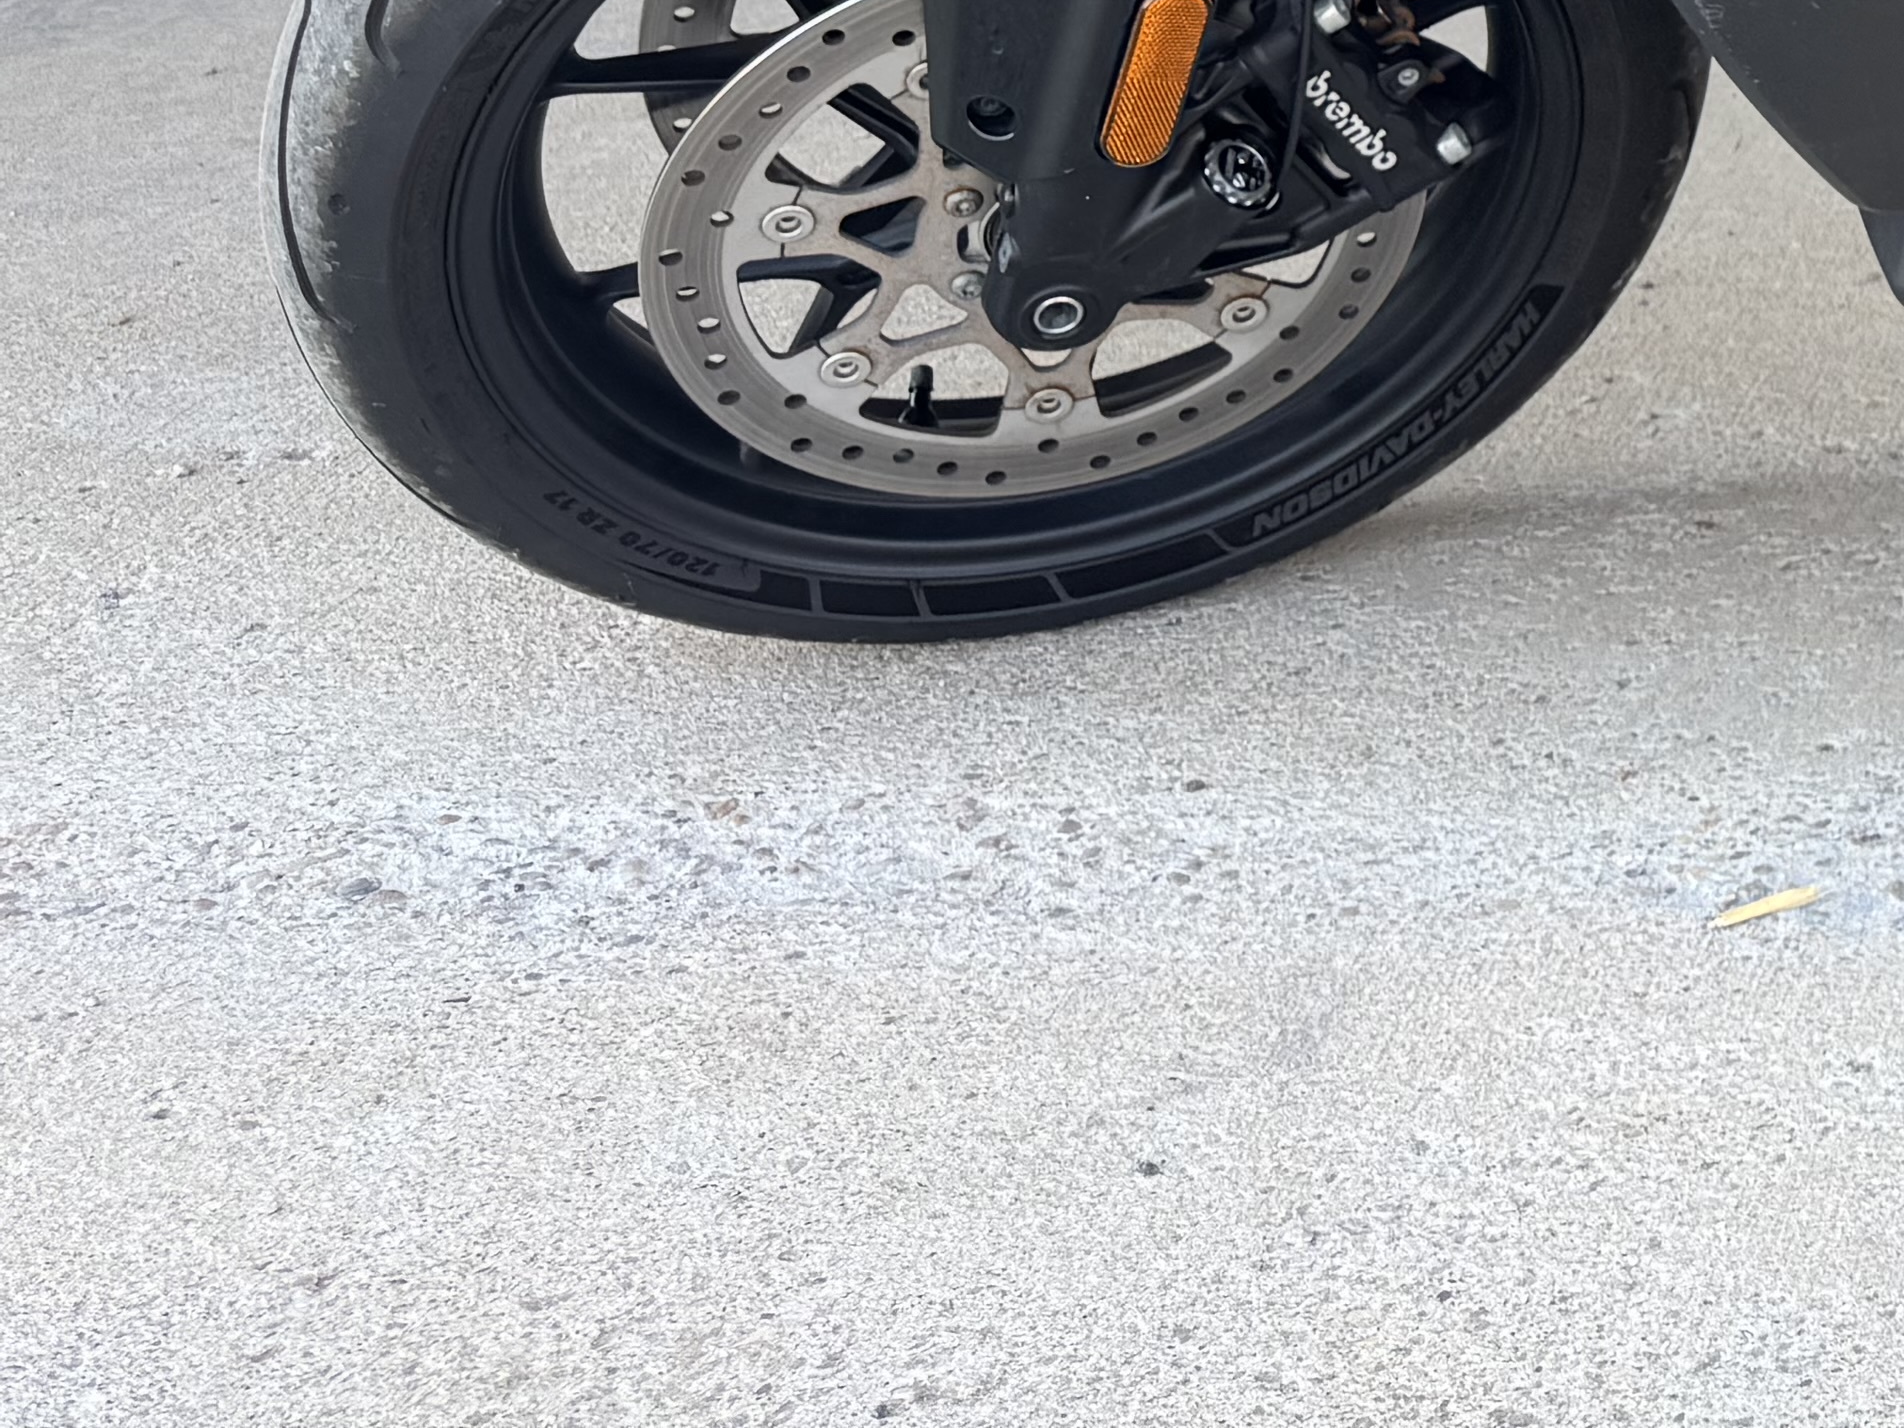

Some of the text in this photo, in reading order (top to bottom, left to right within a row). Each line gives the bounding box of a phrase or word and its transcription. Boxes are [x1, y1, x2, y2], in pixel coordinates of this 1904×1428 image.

[1305, 70, 1398, 172] brembo
[1250, 300, 1542, 539] HARLEY-DAVIDSON
[542, 489, 722, 577] 120/70 ZR 17
